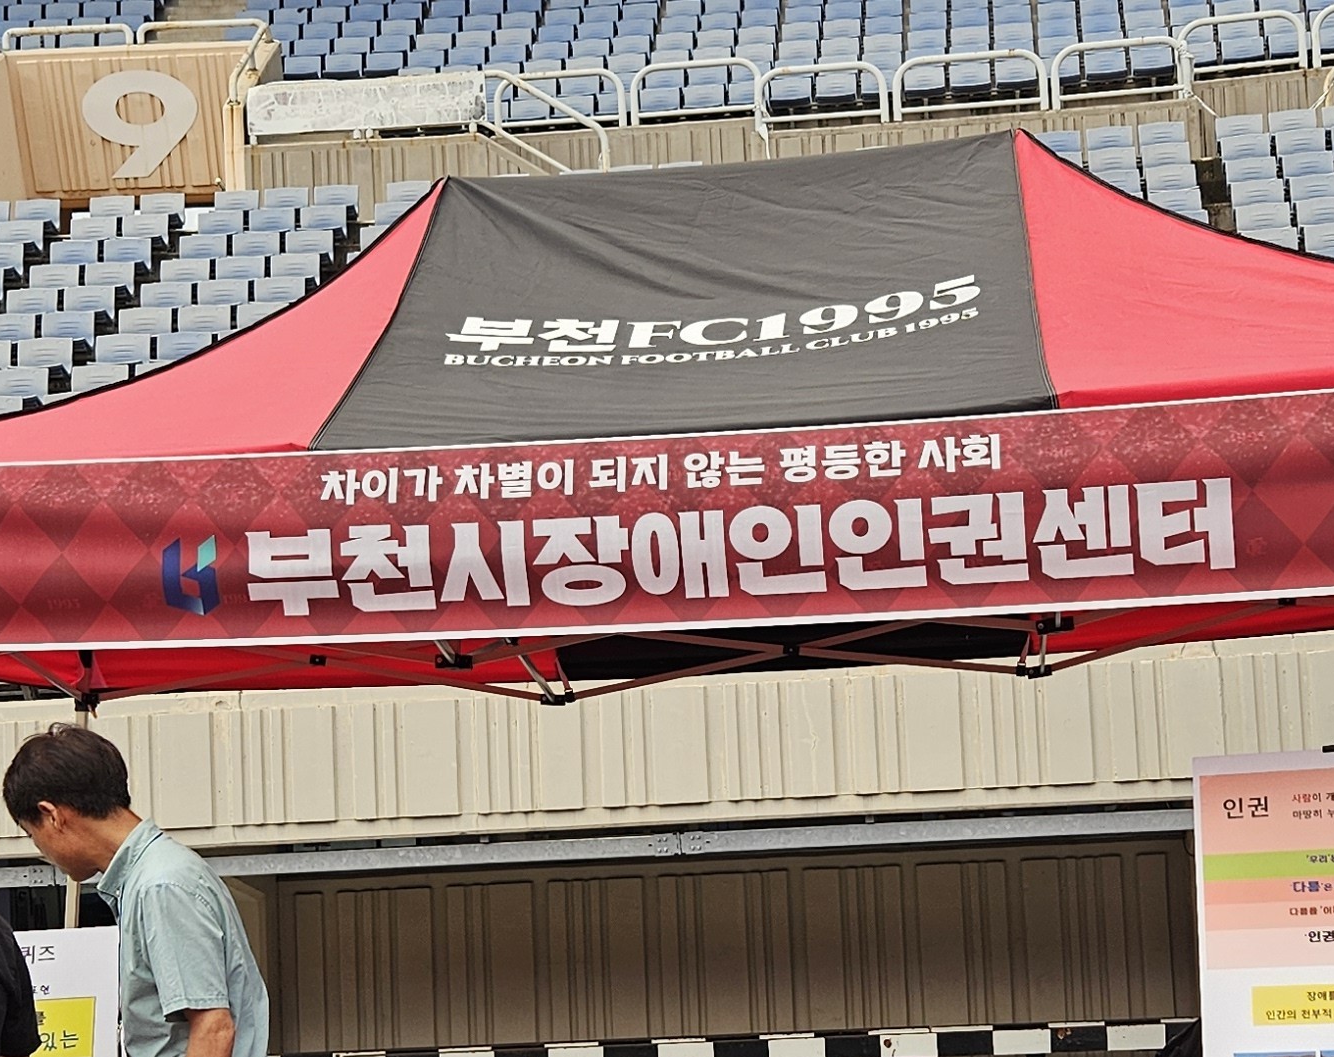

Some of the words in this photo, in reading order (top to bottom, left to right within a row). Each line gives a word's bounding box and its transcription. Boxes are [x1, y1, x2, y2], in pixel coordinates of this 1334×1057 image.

[81, 70, 198, 179] 9
[444, 353, 612, 367] BUCHEON
[621, 343, 801, 364] FOOTBALL
[806, 327, 898, 351] CLUB
[904, 307, 979, 334] 1995
[446, 275, 981, 352] 부천FC1995
[320, 467, 443, 505] 차이가
[454, 459, 574, 499] 차별이
[589, 454, 668, 493] 되지
[683, 451, 765, 489] 않는
[779, 440, 906, 483] 평등한
[918, 433, 1001, 473] 사회
[246, 478, 1237, 618] 부천시장애인인권센터
[1222, 796, 1269, 819] 인권
[1292, 793, 1322, 804] 사람이
[1292, 808, 1323, 820] 마땅히
[1266, 1009, 1296, 1020] 인간의
